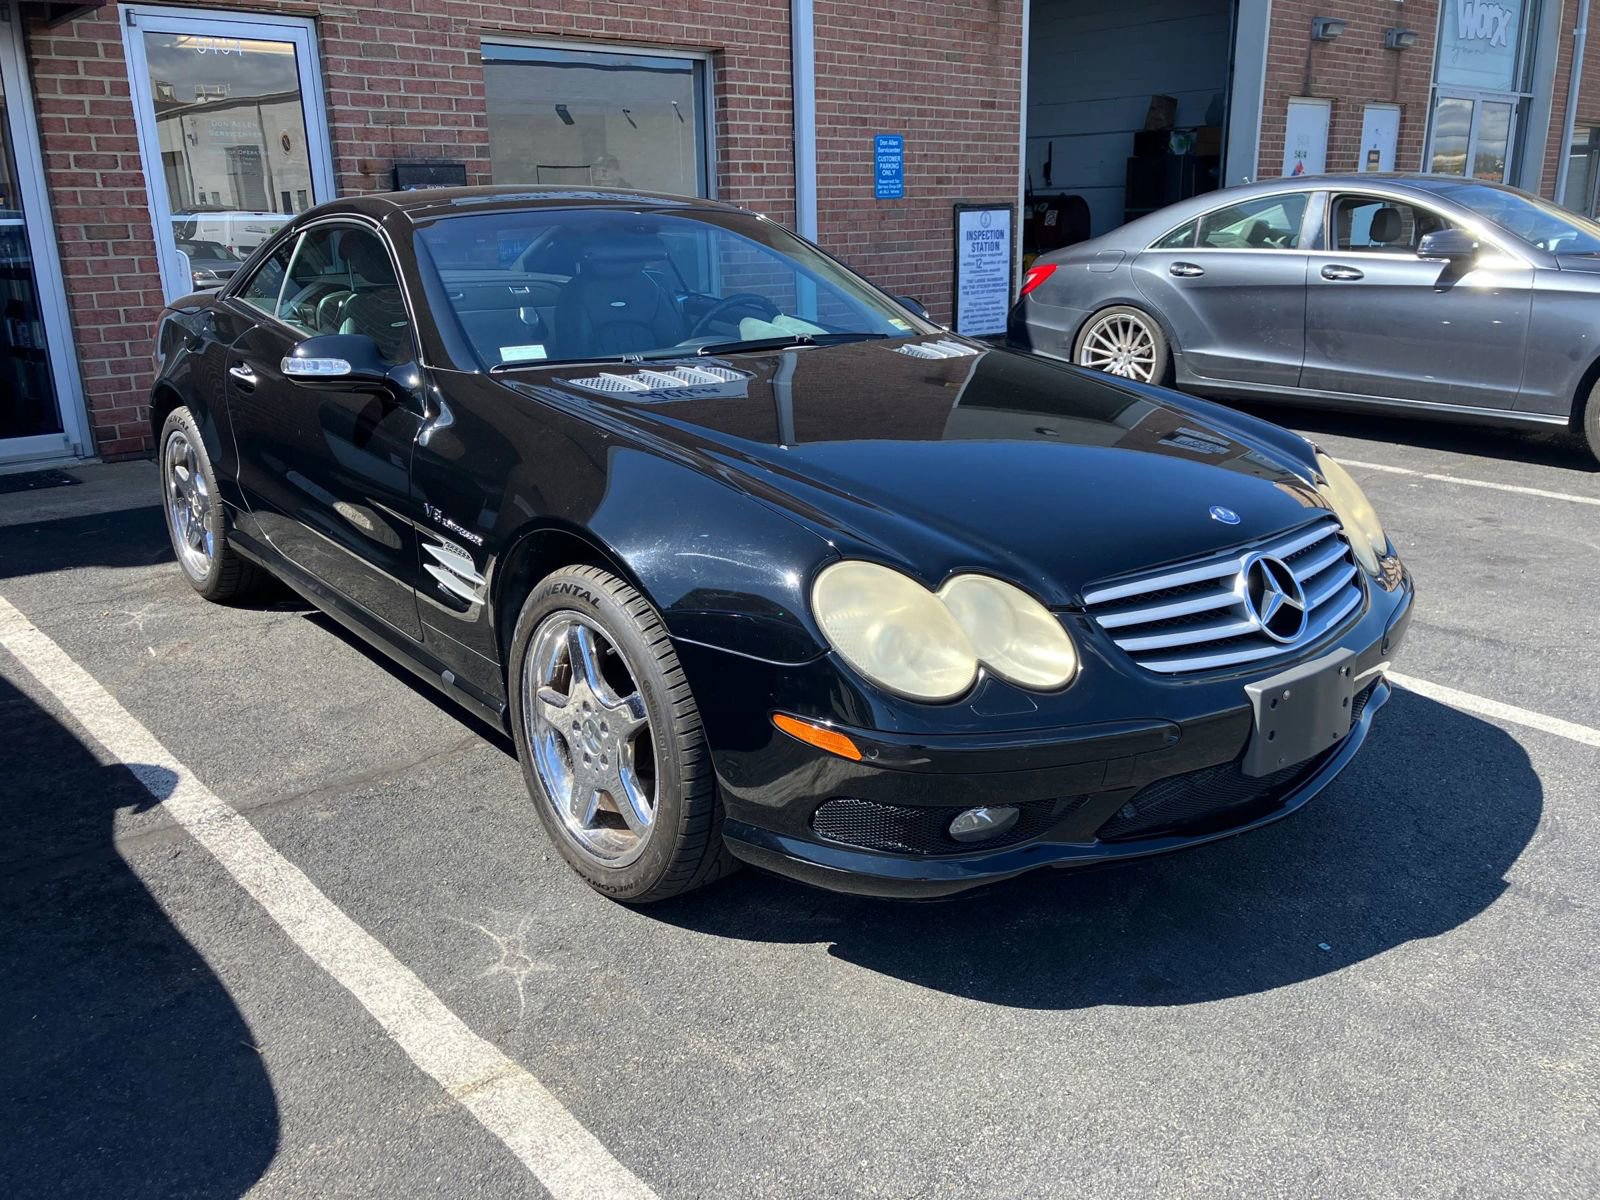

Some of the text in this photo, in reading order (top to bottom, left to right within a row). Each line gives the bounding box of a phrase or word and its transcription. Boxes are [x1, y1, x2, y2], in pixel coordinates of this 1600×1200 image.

[1457, 0, 1512, 48] Worx
[966, 229, 1005, 241] INSPECTION
[971, 241, 1001, 253] STATION
[976, 258, 983, 269] 12
[424, 503, 442, 523] V8
